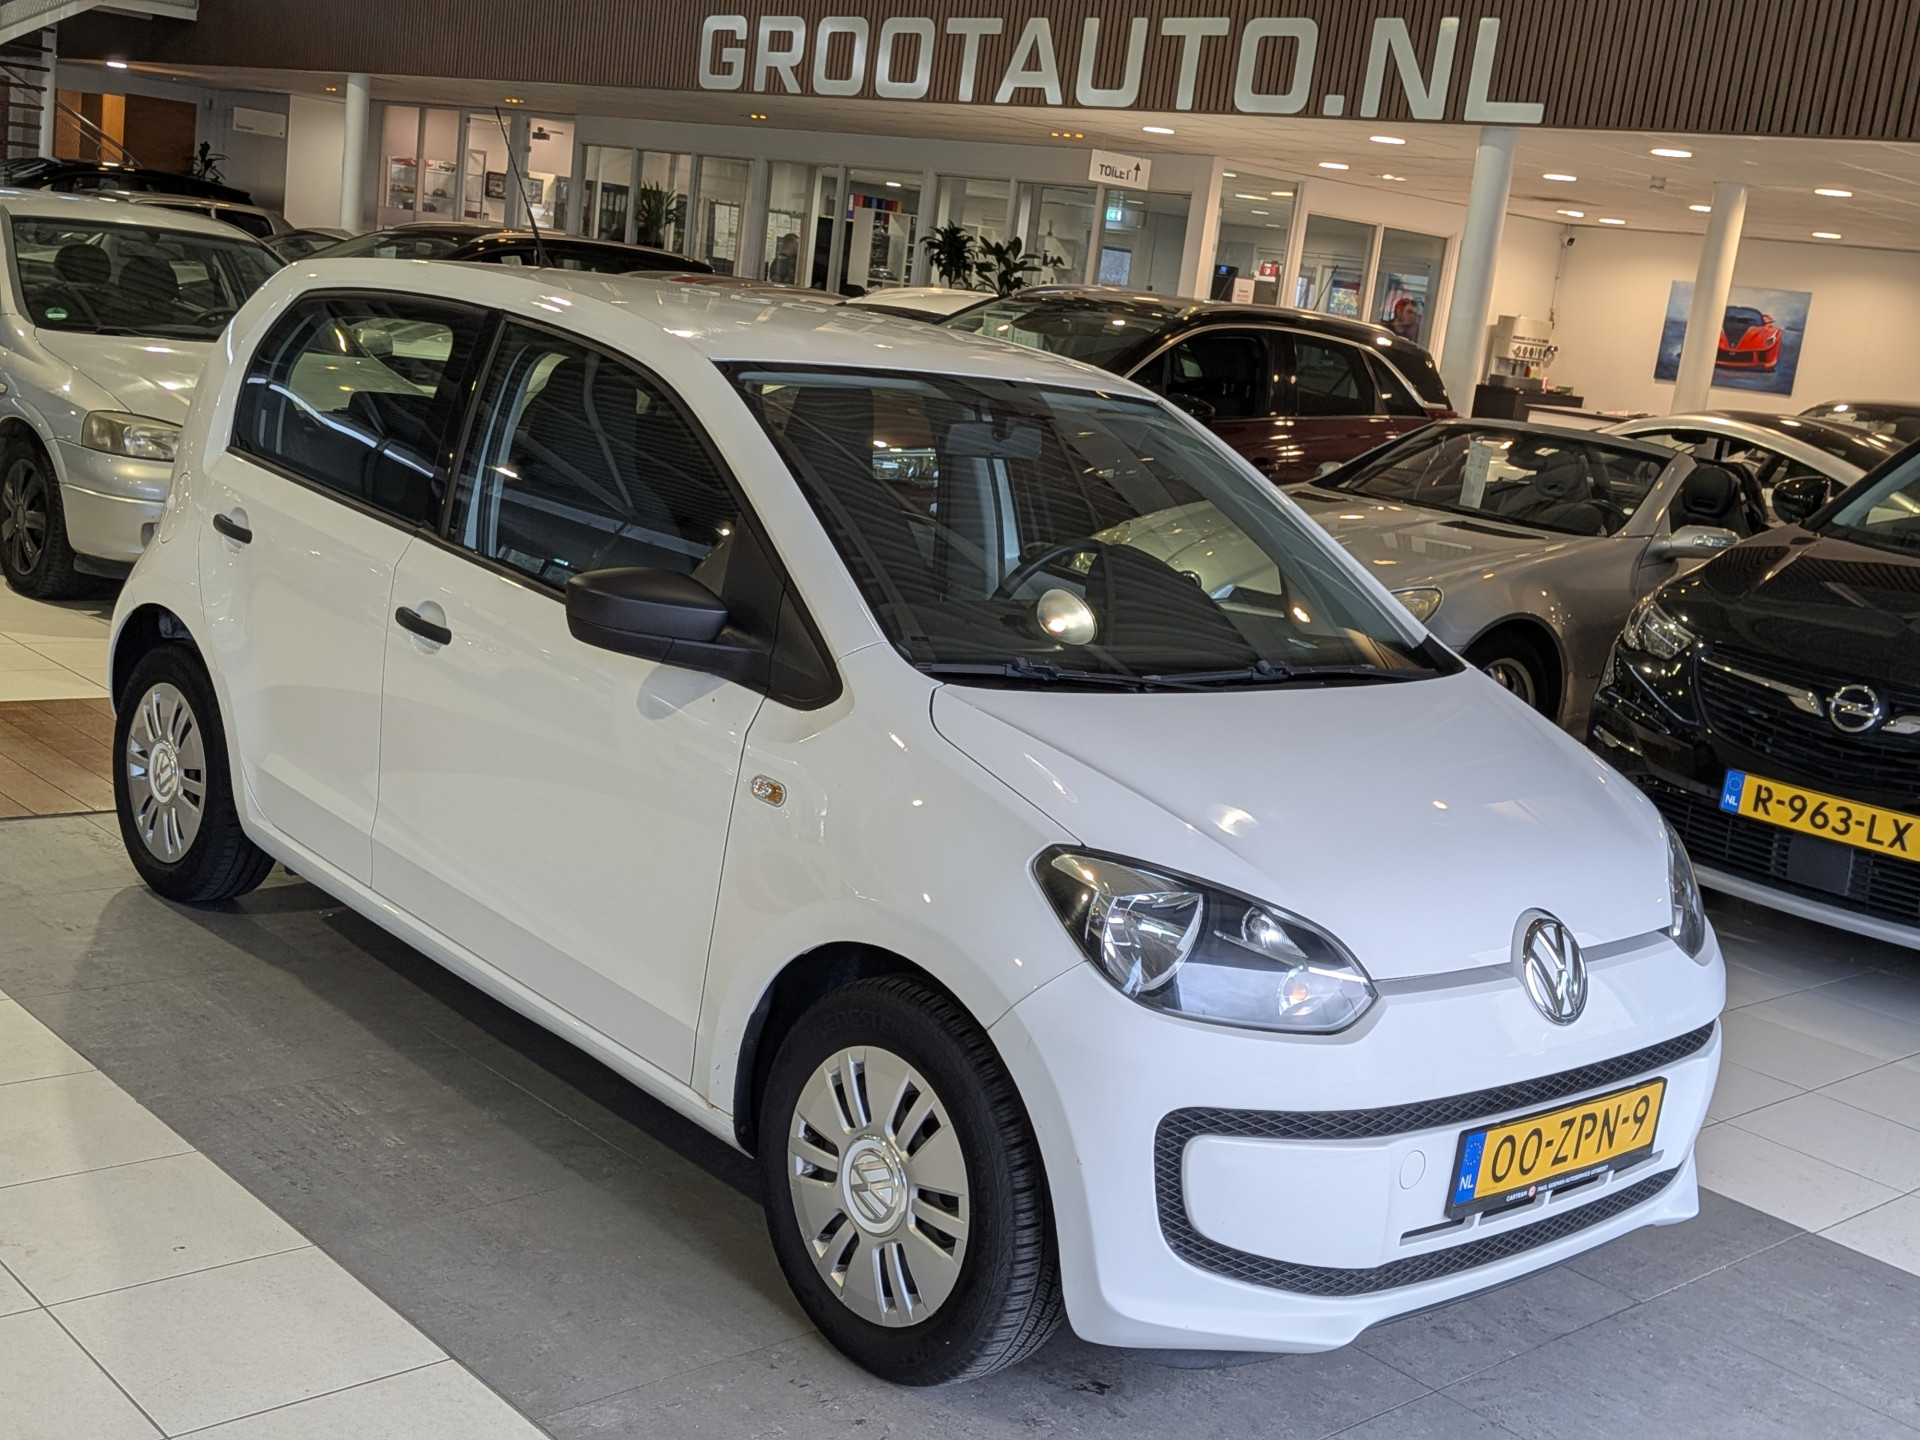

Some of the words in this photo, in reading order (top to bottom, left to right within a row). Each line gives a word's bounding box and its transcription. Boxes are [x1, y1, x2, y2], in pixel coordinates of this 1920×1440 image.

[699, 15, 1545, 124] GROOTAUTO.NL
[1099, 163, 1131, 180] TOILET
[1725, 793, 1738, 806] NL
[1753, 784, 1914, 852] R-963-LX
[1491, 1095, 1650, 1184] 00-ZPN-9
[1459, 1174, 1474, 1191] NL
[1506, 1191, 1528, 1202] CARTEAM
